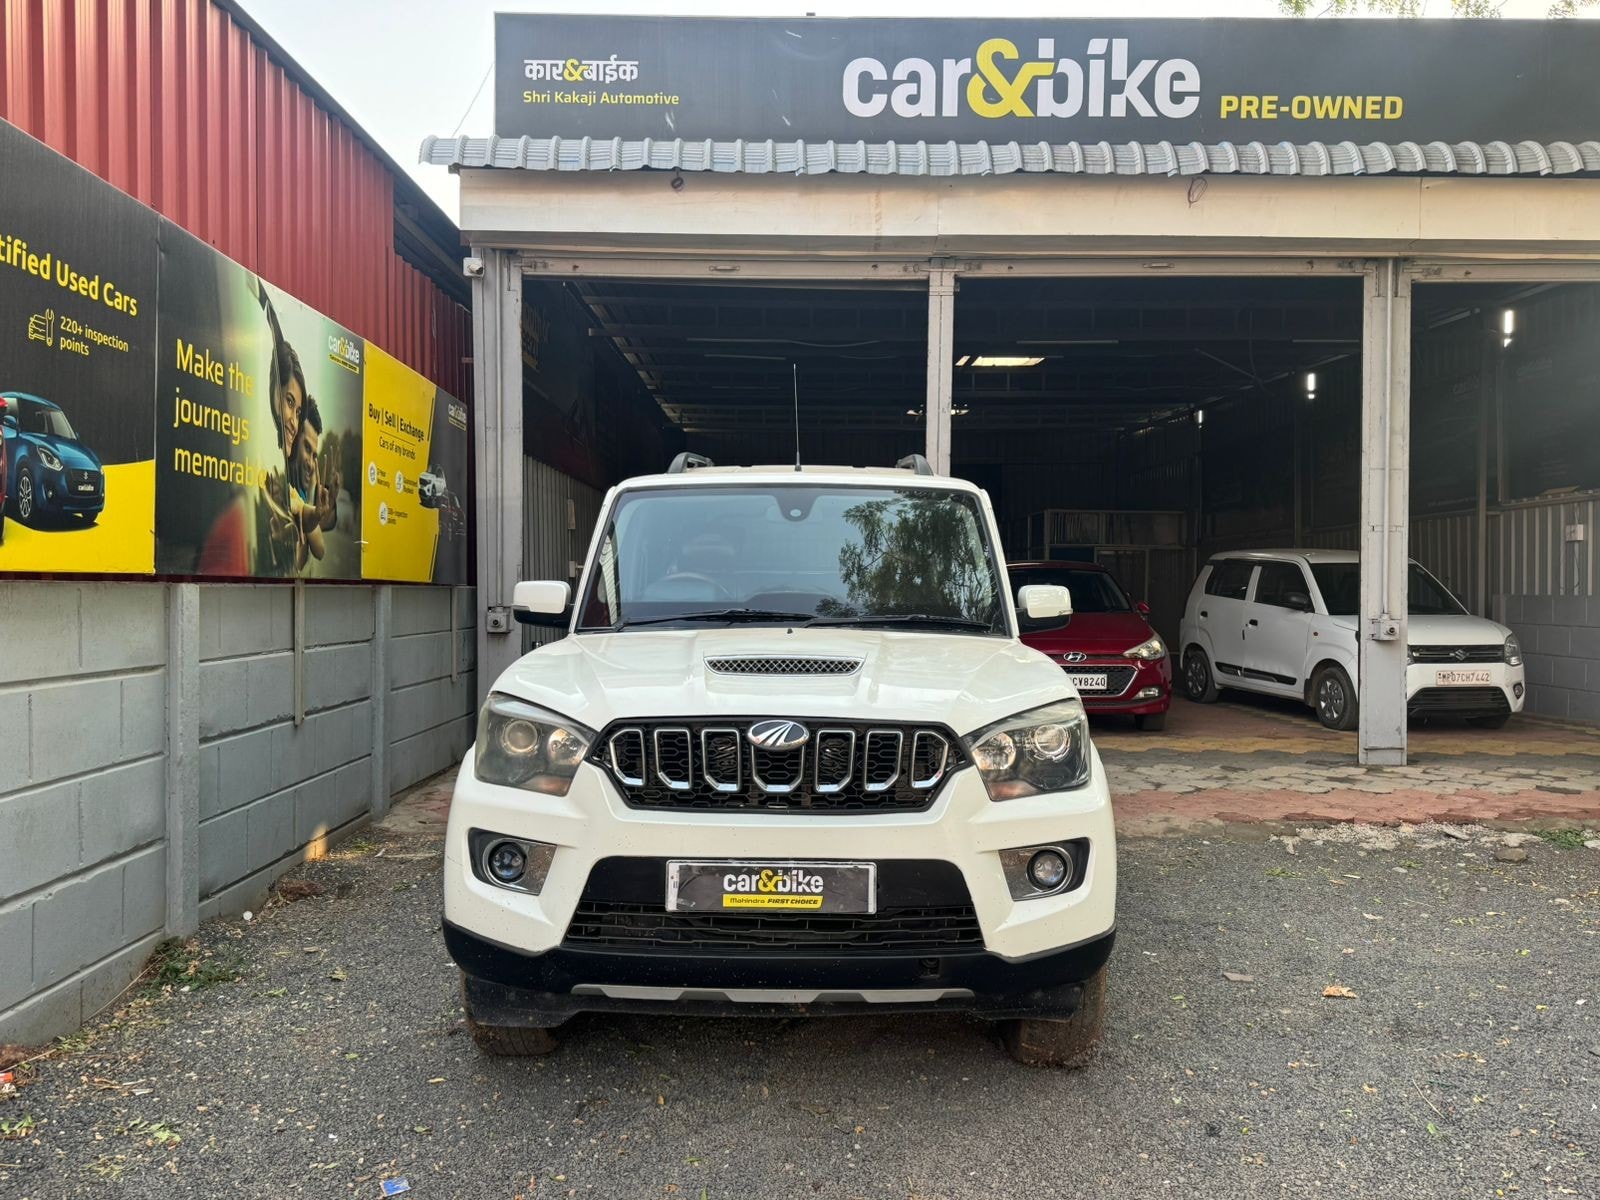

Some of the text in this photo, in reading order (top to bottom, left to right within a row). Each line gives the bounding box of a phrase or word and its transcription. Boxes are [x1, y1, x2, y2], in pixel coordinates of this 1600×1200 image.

[523, 54, 640, 84] कार&बाईक
[843, 38, 1201, 119] car&bike
[523, 91, 680, 106] Shri Kakaji Automotive
[1219, 94, 1404, 120] PRE-OWNED
[56, 260, 99, 301] Used
[103, 282, 138, 316] Cars
[60, 316, 129, 353] 220+ inspection
[60, 337, 90, 356] points
[176, 338, 255, 397] Make the
[173, 386, 250, 446] journeys
[368, 403, 382, 424] Buy
[384, 411, 397, 429] Sell
[399, 418, 425, 443] Exchange
[1070, 677, 1106, 687] CV8240
[723, 869, 824, 893] car&bike
